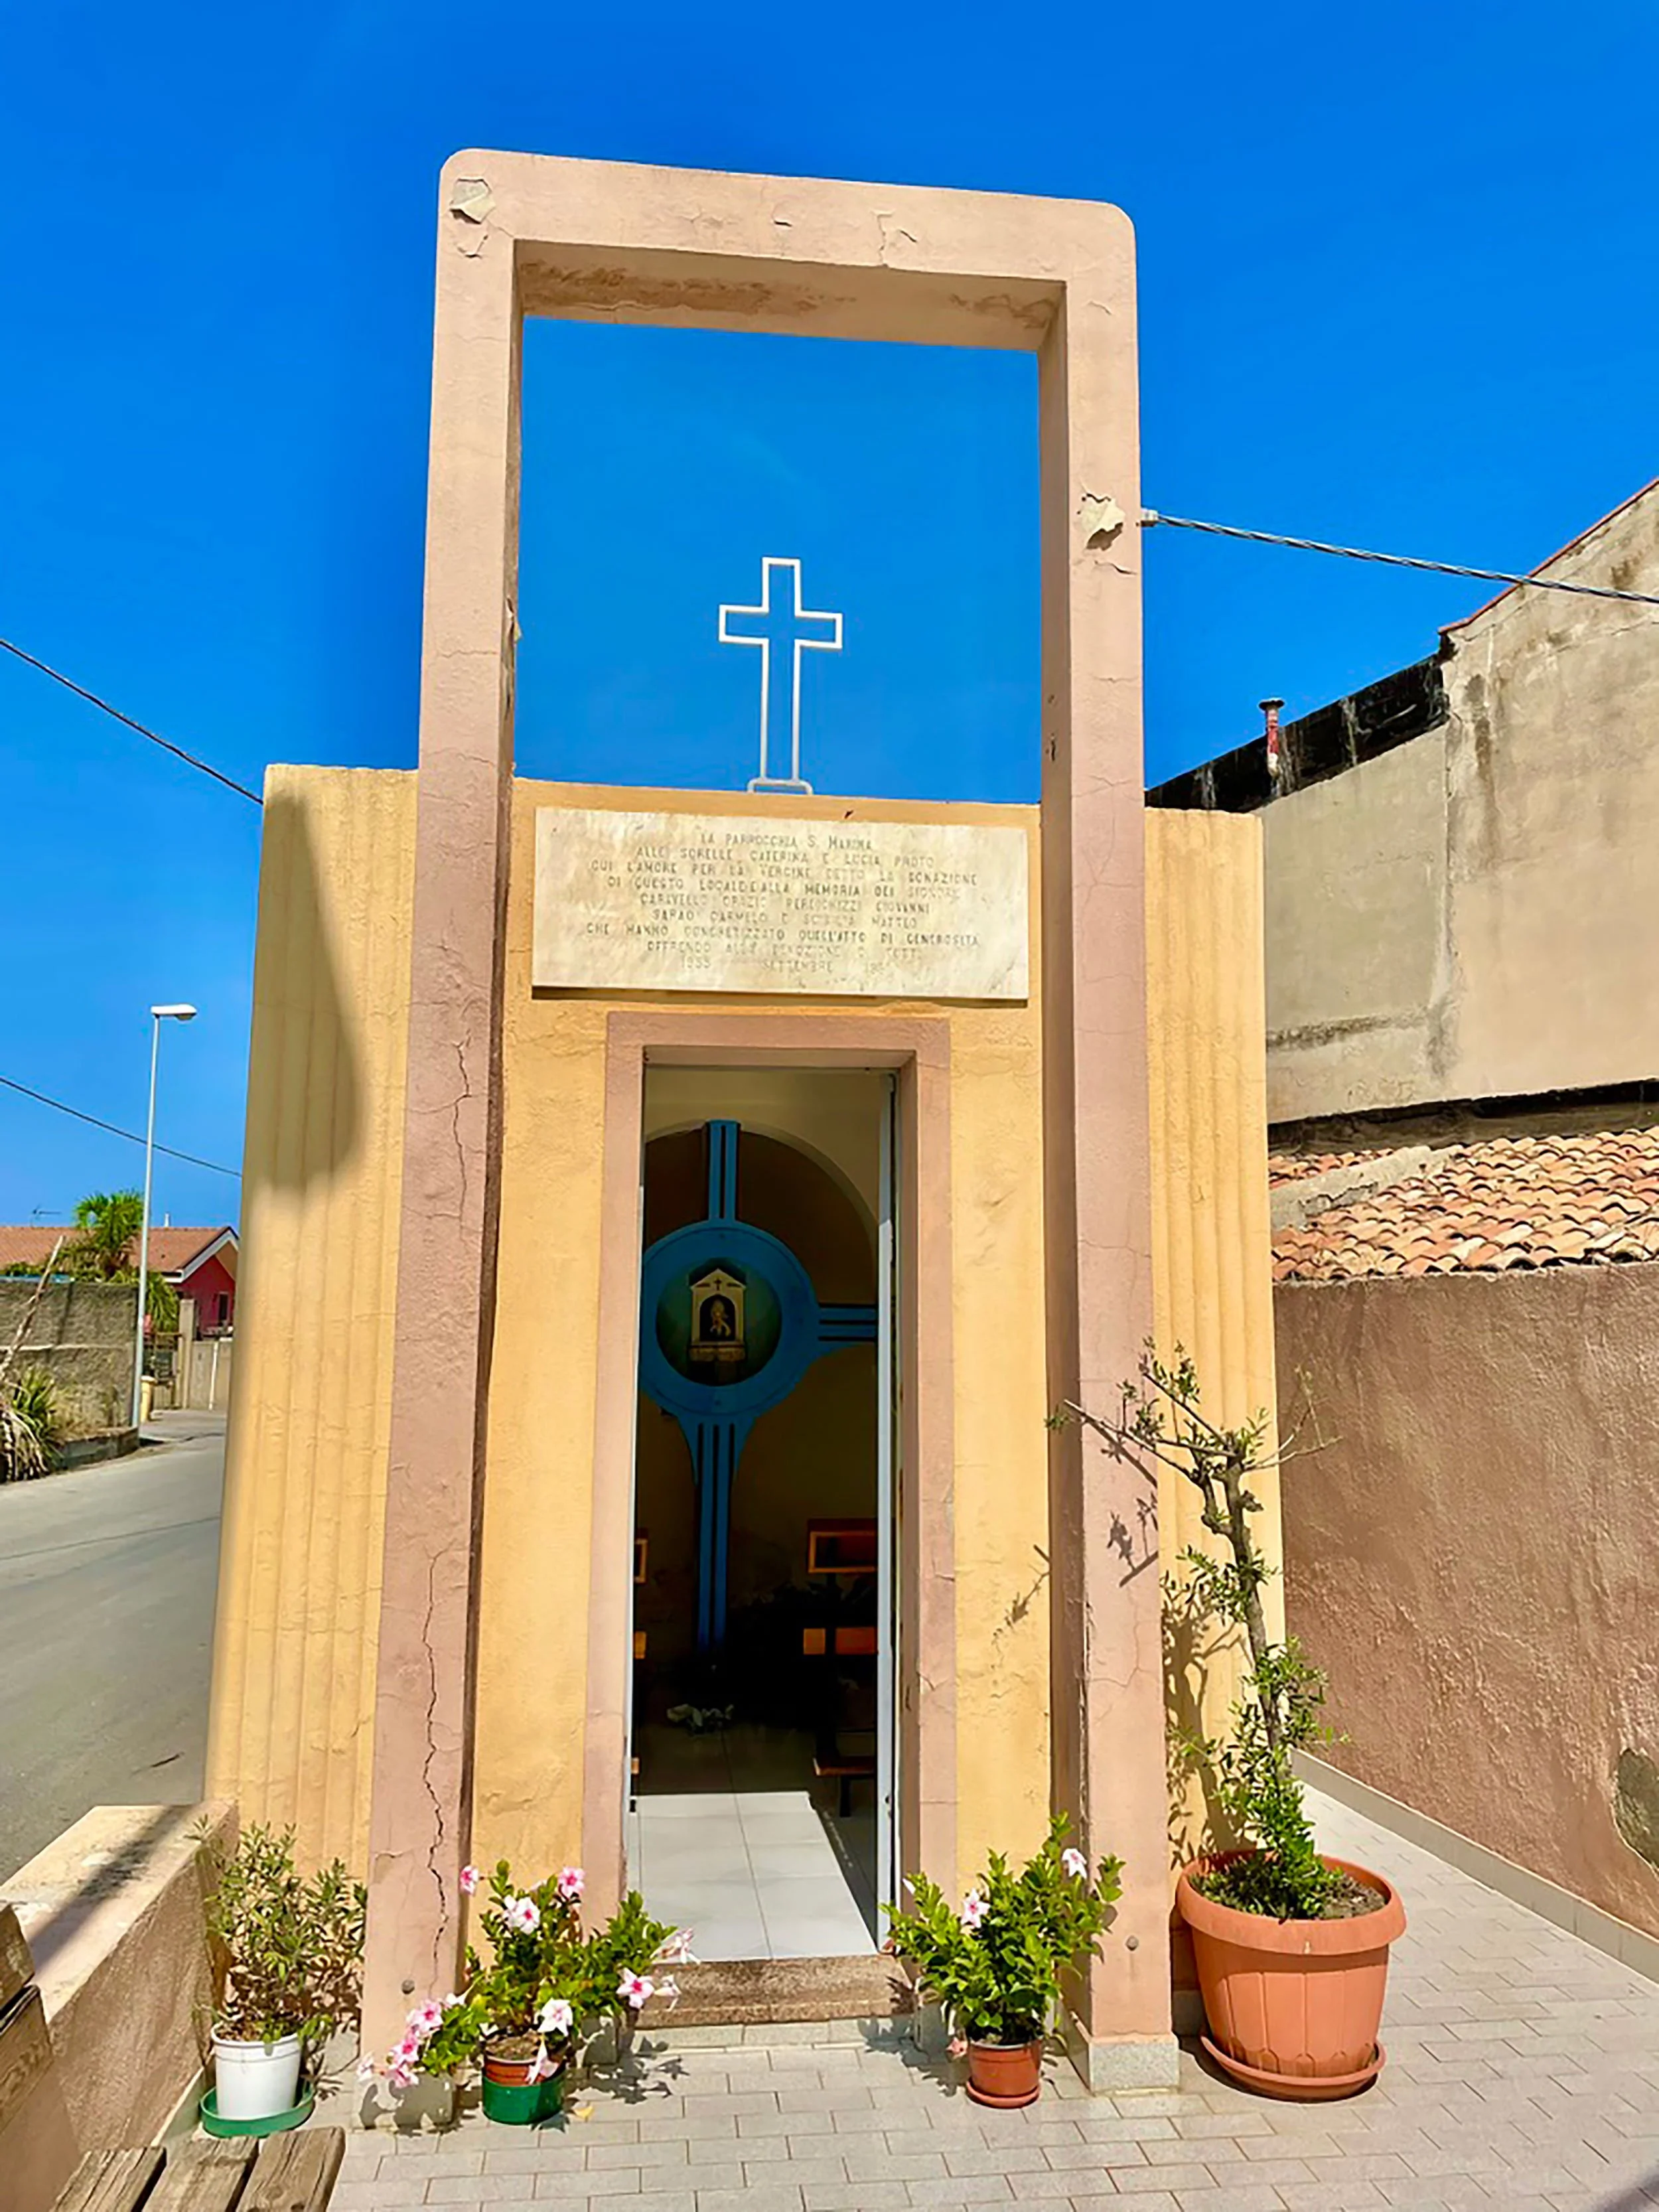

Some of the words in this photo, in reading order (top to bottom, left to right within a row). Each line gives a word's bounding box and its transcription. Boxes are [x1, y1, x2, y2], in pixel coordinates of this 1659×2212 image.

[701, 834, 715, 844] LA
[726, 833, 798, 848] PARROCCHIA
[637, 846, 666, 858] ALLE
[680, 848, 733, 861] SORELLE
[749, 849, 809, 863] CATERINA
[845, 853, 880, 865] LUCIA
[895, 856, 934, 868] PROTO
[693, 863, 715, 875] PER
[730, 865, 743, 876] LA
[759, 864, 810, 879] VERGINE
[908, 871, 977, 886] DONAZIONE
[607, 876, 621, 887] DI
[634, 876, 684, 890] QUESTO
[805, 883, 860, 896] MEMORIA
[874, 885, 894, 897] DEI
[876, 901, 929, 914] GIOVANNI
[710, 911, 768, 924] CARMELO
[872, 915, 917, 929] MATTEO
[587, 922, 609, 935] CHE
[626, 924, 668, 936] HANNO
[881, 932, 893, 944] DI
[648, 940, 711, 953] OFFRENDO
